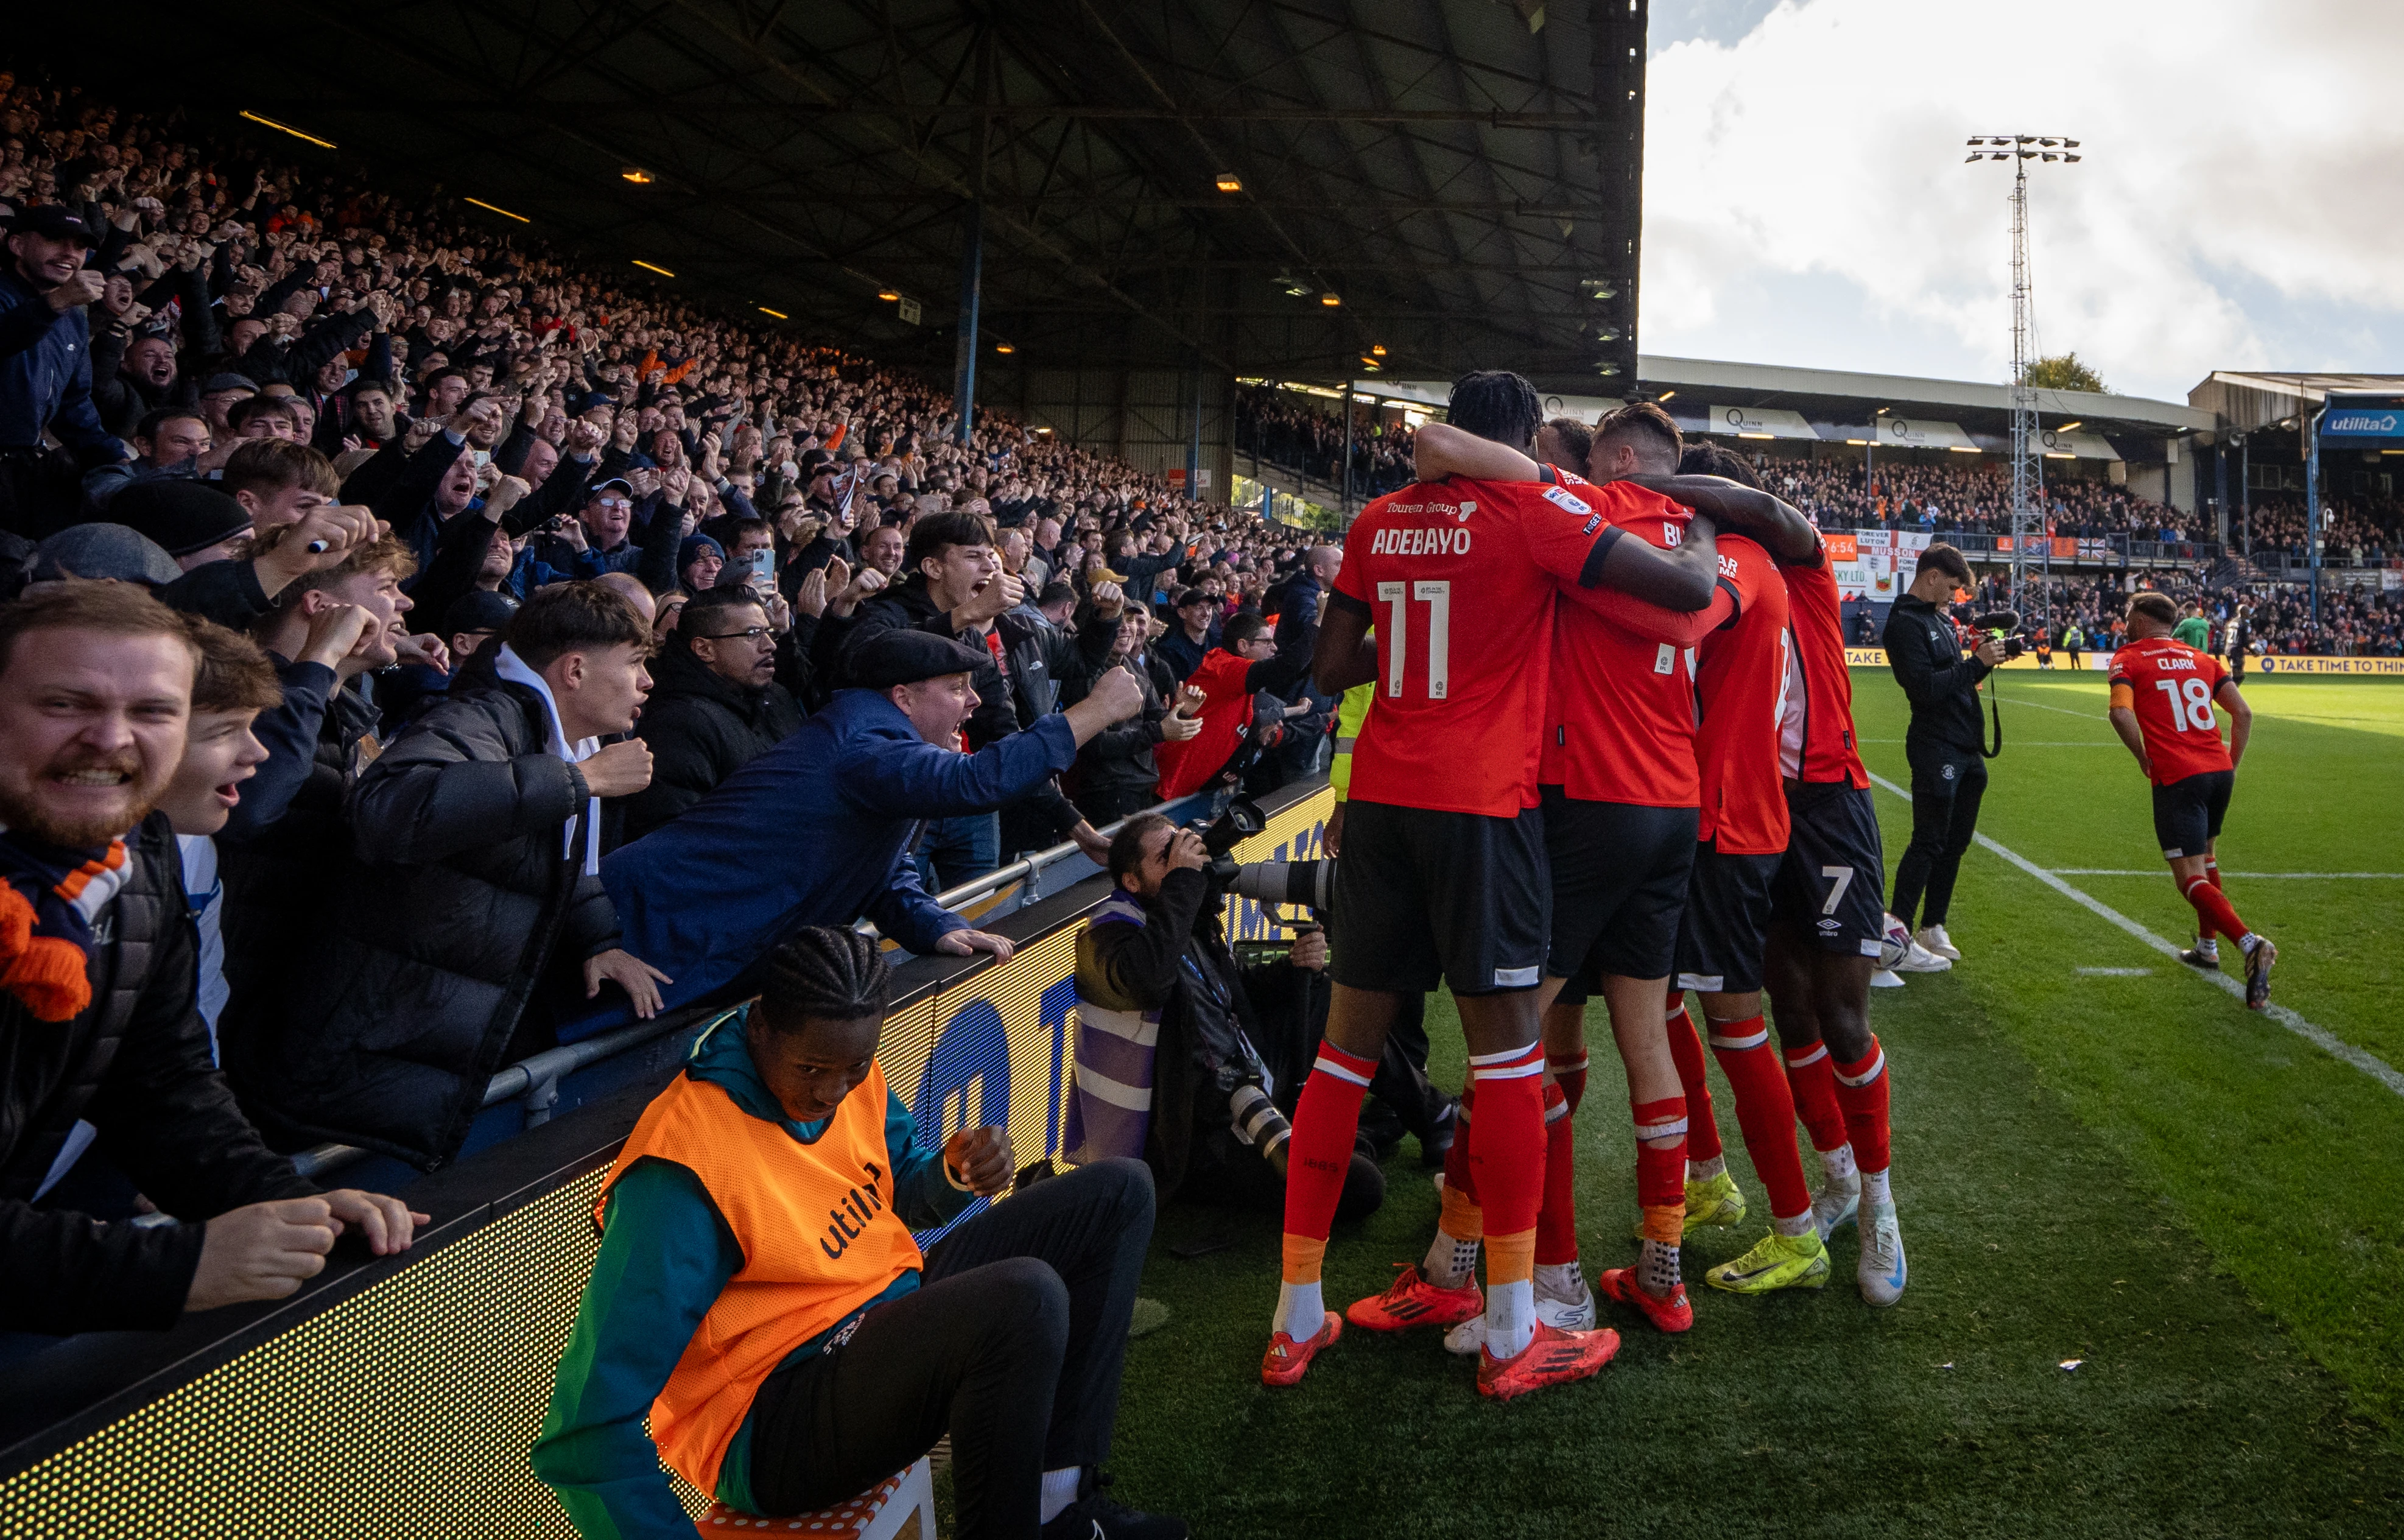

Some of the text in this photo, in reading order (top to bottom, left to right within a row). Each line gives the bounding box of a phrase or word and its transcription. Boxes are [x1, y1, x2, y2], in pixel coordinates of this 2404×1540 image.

[1726, 409, 1762, 427] QUINN
[2332, 417, 2380, 431] utilita
[1892, 420, 1925, 438] QUINN
[2042, 431, 2072, 450] QUINN
[1387, 502, 1457, 515] Toureen Group
[1371, 528, 1471, 555] ADEBAYO
[1872, 547, 1916, 557] MUSSON
[1377, 581, 1450, 700] 11
[1846, 652, 1882, 663] TAKE
[2157, 658, 2196, 670] CLARK
[2279, 659, 2313, 670] TAKE
[2318, 660, 2351, 671] TIME
[2354, 661, 2372, 672] TO
[2156, 678, 2216, 732] 18
[1822, 866, 1854, 915] 7
